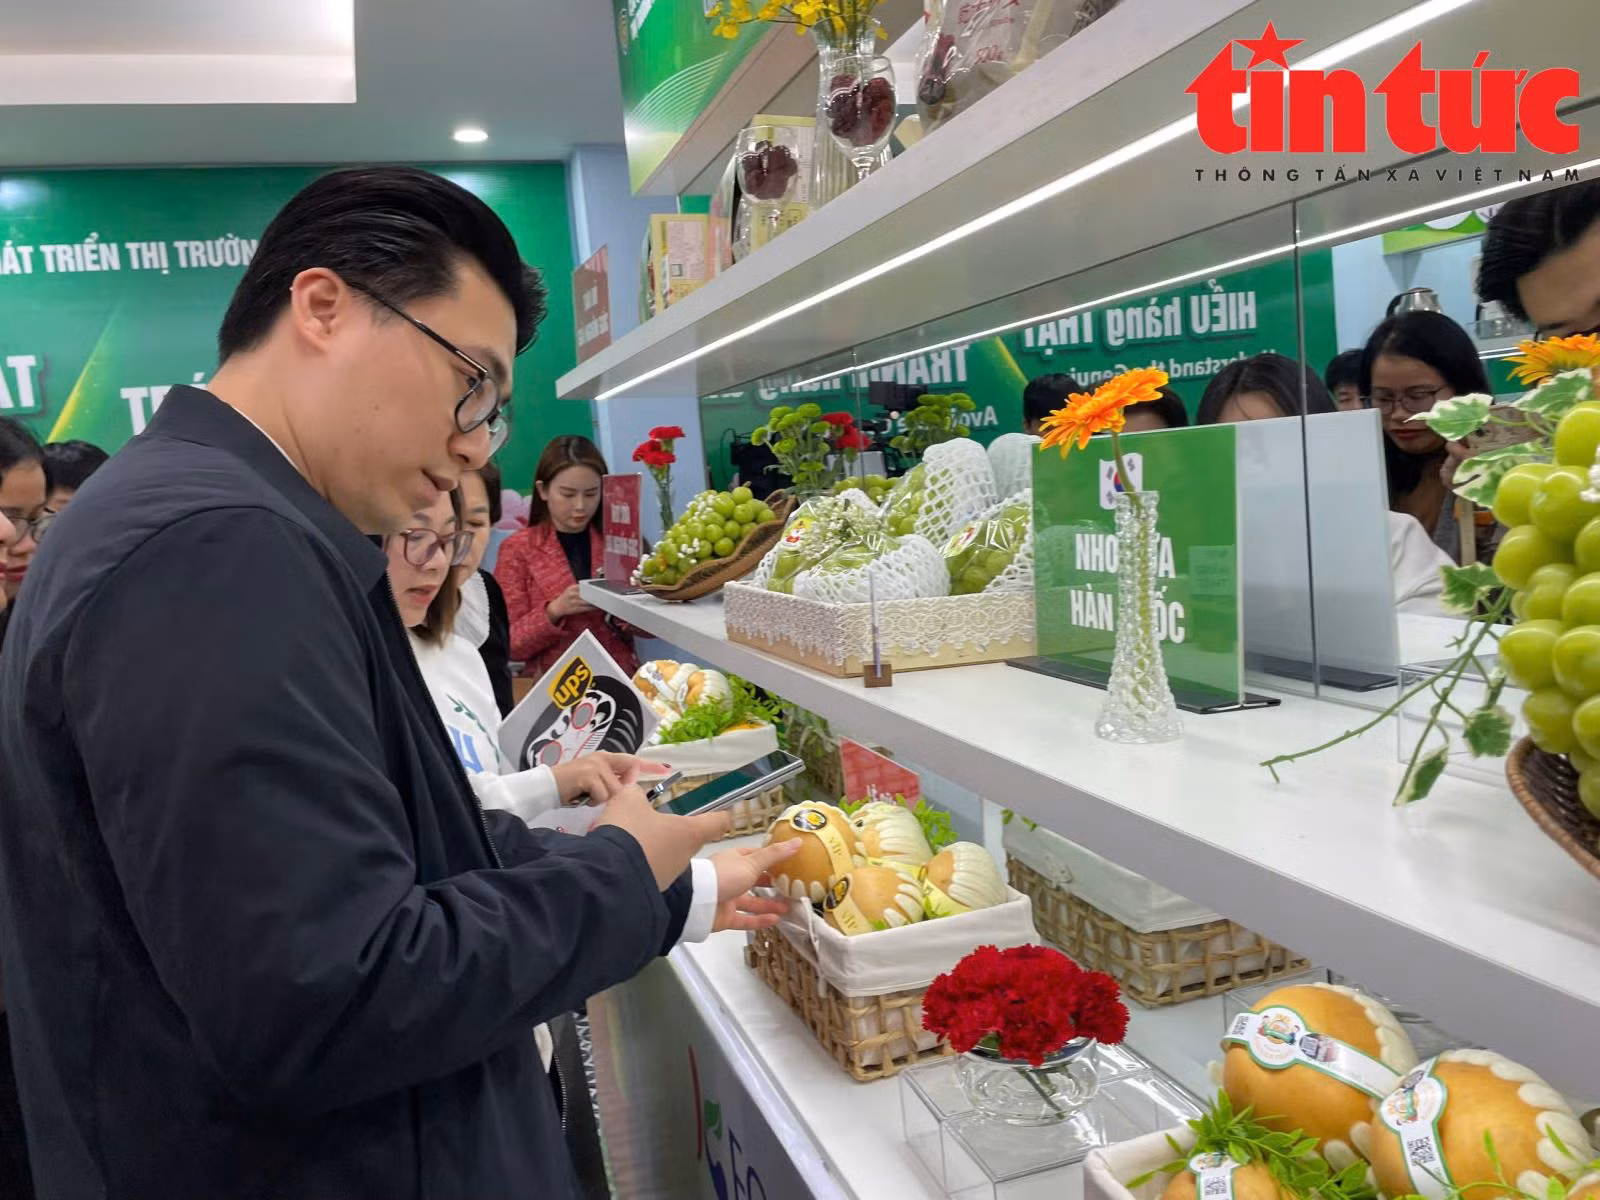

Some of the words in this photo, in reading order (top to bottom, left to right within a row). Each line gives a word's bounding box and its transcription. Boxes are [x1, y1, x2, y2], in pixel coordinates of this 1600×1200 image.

[40, 232, 121, 272] TRIỂN
[125, 241, 170, 275] THỊ
[173, 233, 258, 268] TRƯỜN
[1075, 533, 1120, 574] NHO
[1070, 583, 1114, 631] HÀN
[554, 664, 591, 704] ups
